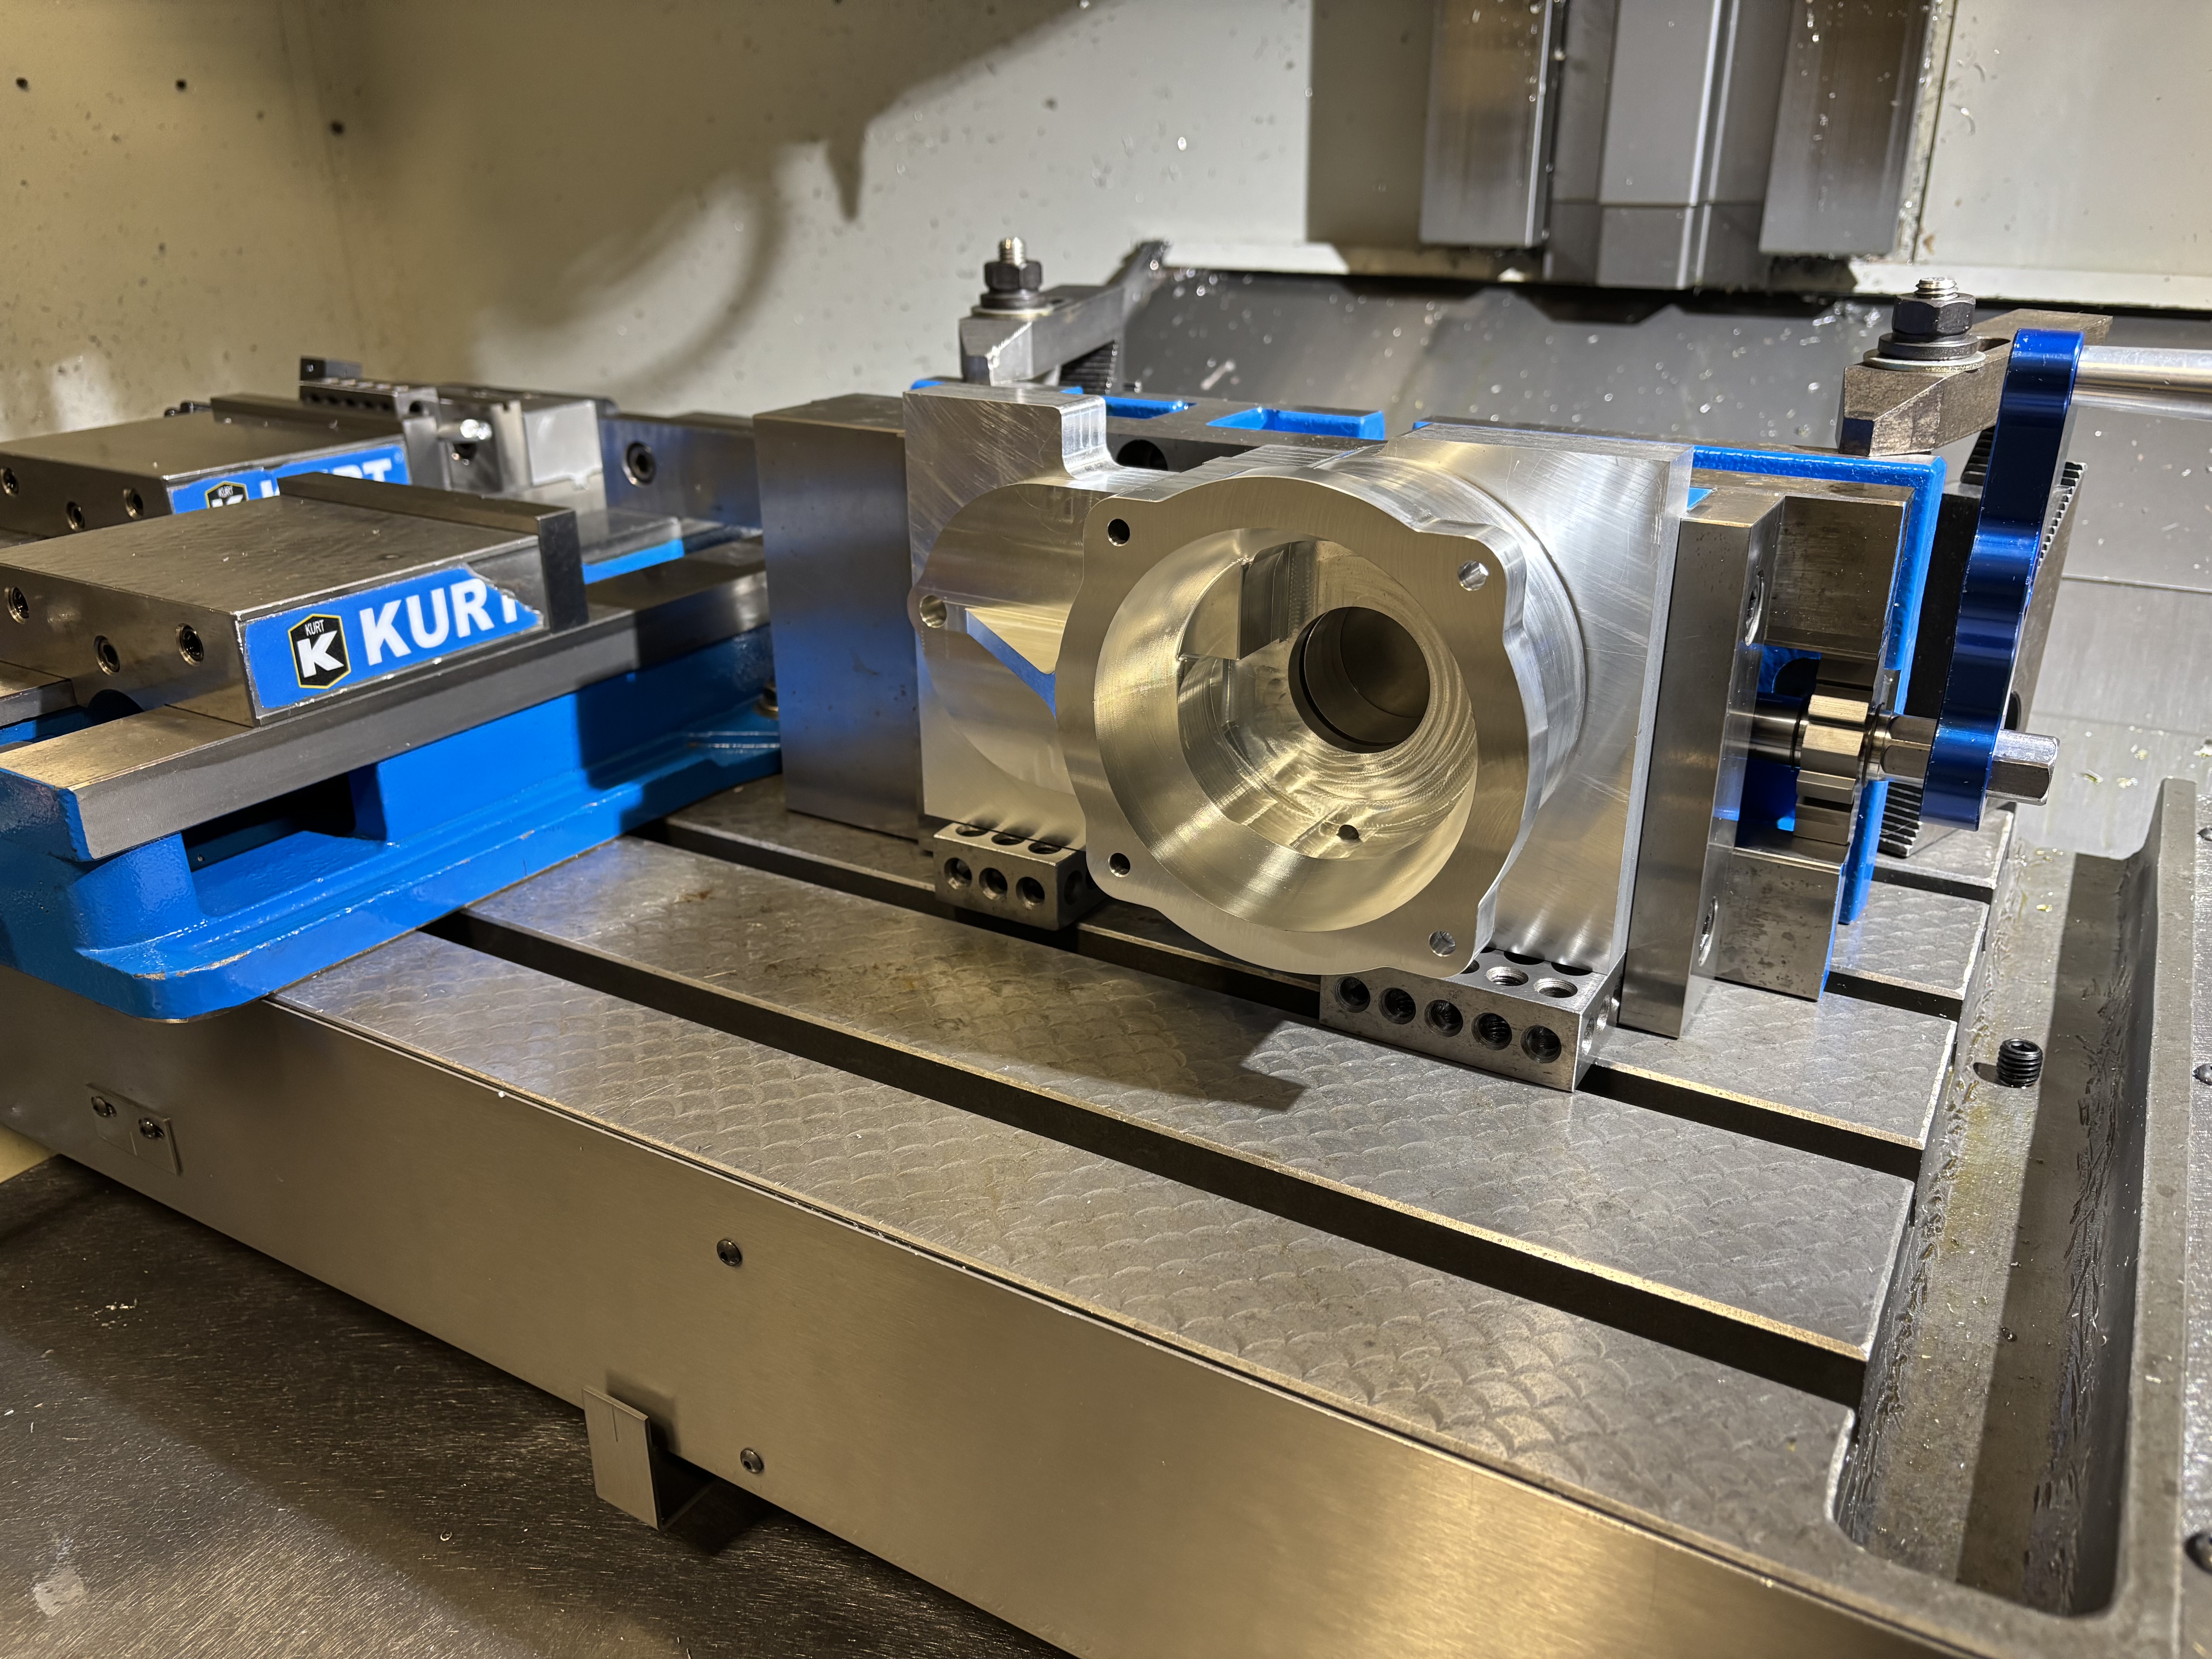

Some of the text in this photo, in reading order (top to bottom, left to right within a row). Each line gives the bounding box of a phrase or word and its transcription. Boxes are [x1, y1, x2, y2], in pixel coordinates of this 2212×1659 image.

[218, 485, 234, 498] KURT
[304, 619, 325, 636] KURT
[297, 630, 344, 678] K
